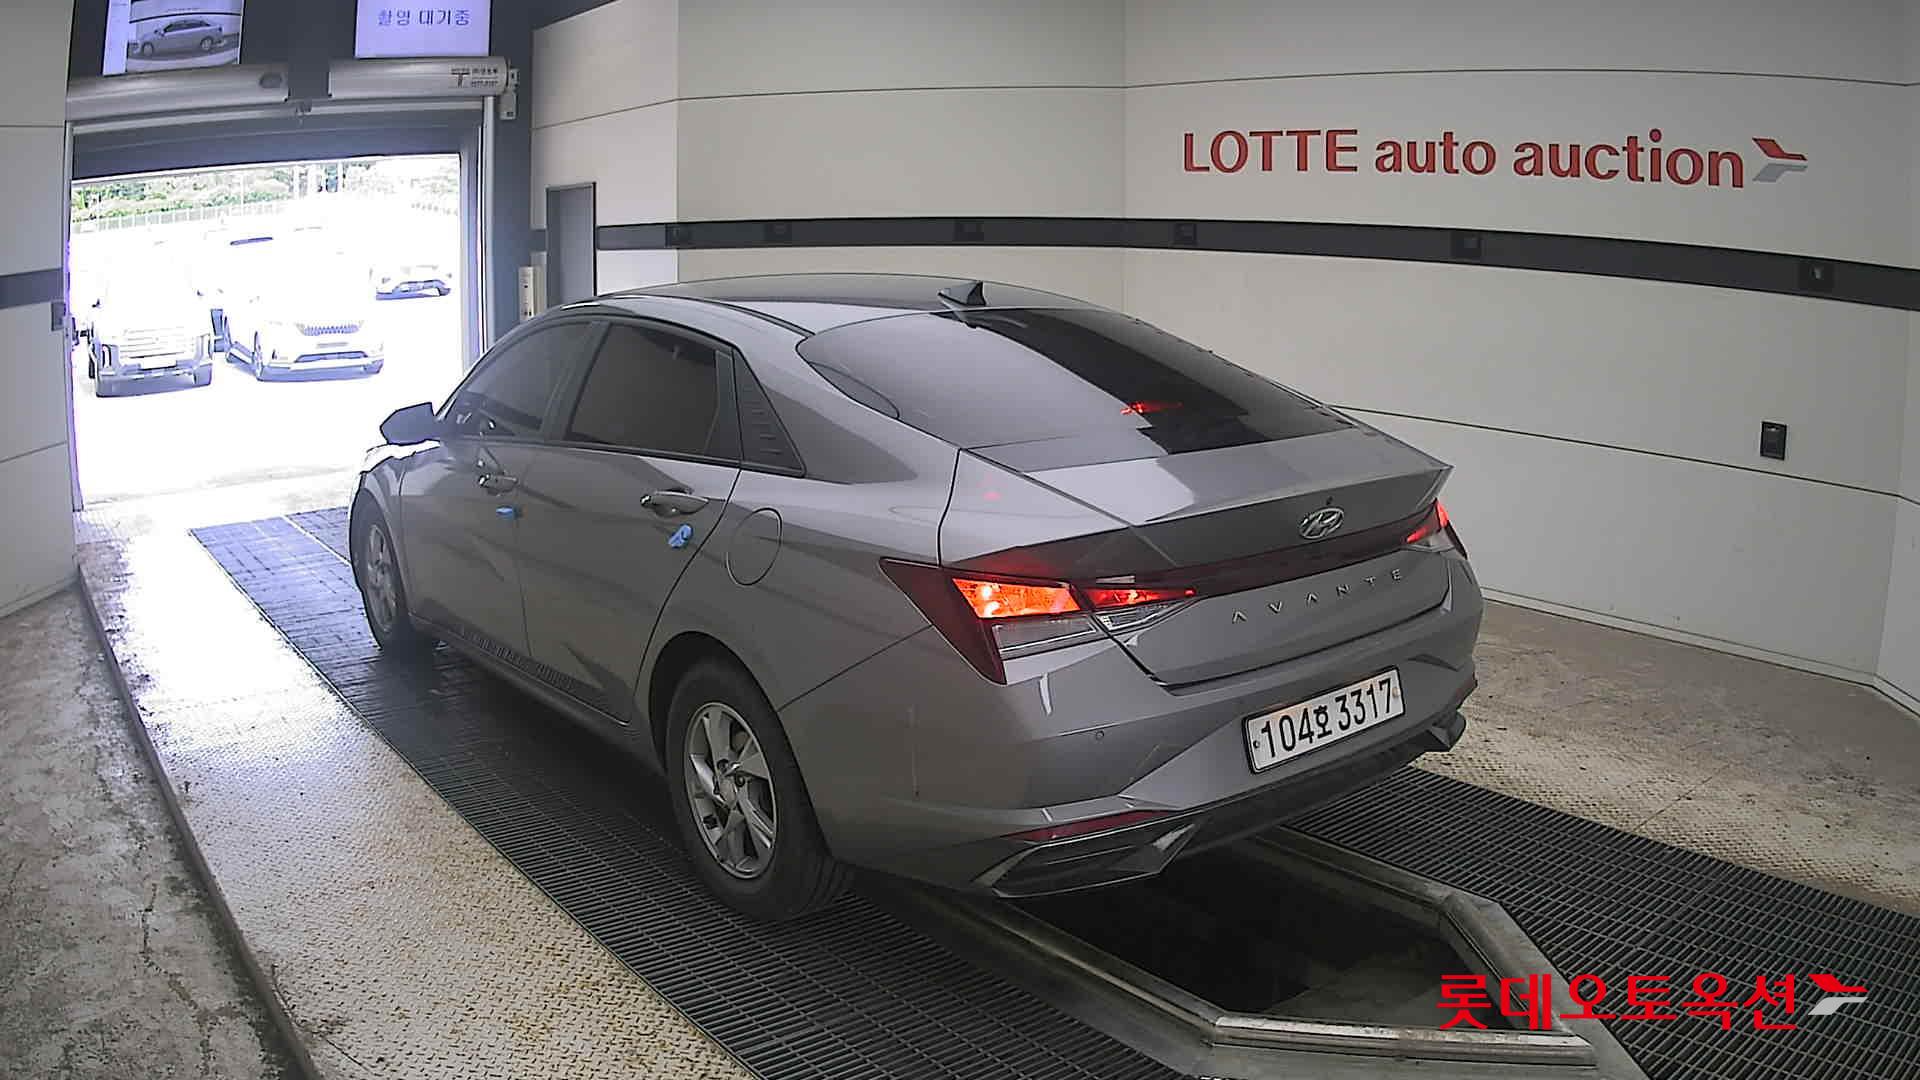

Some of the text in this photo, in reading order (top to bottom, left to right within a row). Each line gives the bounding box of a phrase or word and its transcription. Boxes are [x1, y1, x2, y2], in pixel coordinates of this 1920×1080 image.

[419, 9, 471, 26] 대기중
[1184, 128, 1744, 188] LOTTE auto auction
[1232, 568, 1403, 624] AVANTE
